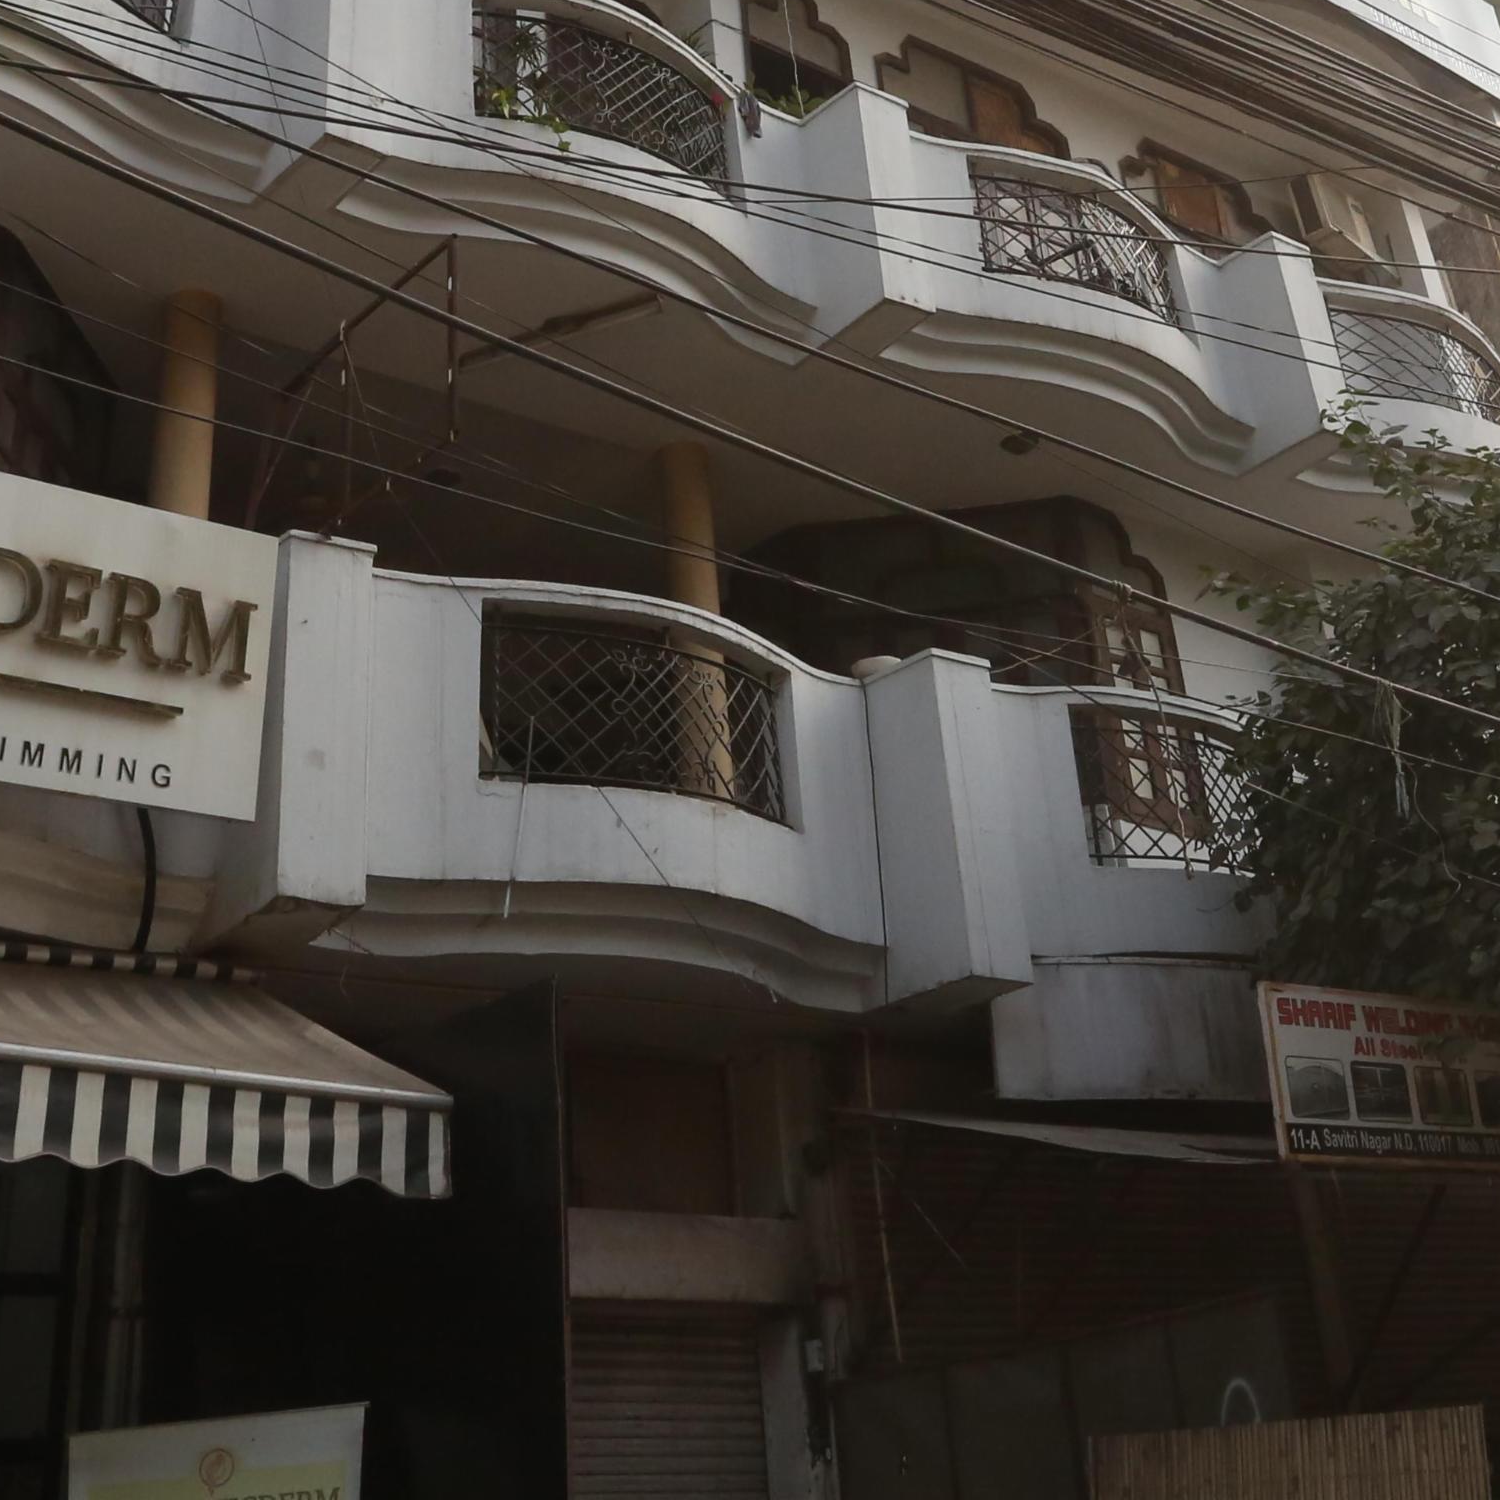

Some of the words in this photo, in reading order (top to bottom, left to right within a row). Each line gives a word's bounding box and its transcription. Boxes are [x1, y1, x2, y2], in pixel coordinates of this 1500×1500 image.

[1277, 997, 1357, 1031] SHARIF
[1354, 1036, 1376, 1057] All
[1291, 1127, 1321, 1151] 11-A
[1323, 1128, 1358, 1149] Savitri
[1361, 1131, 1392, 1155] Nagar
